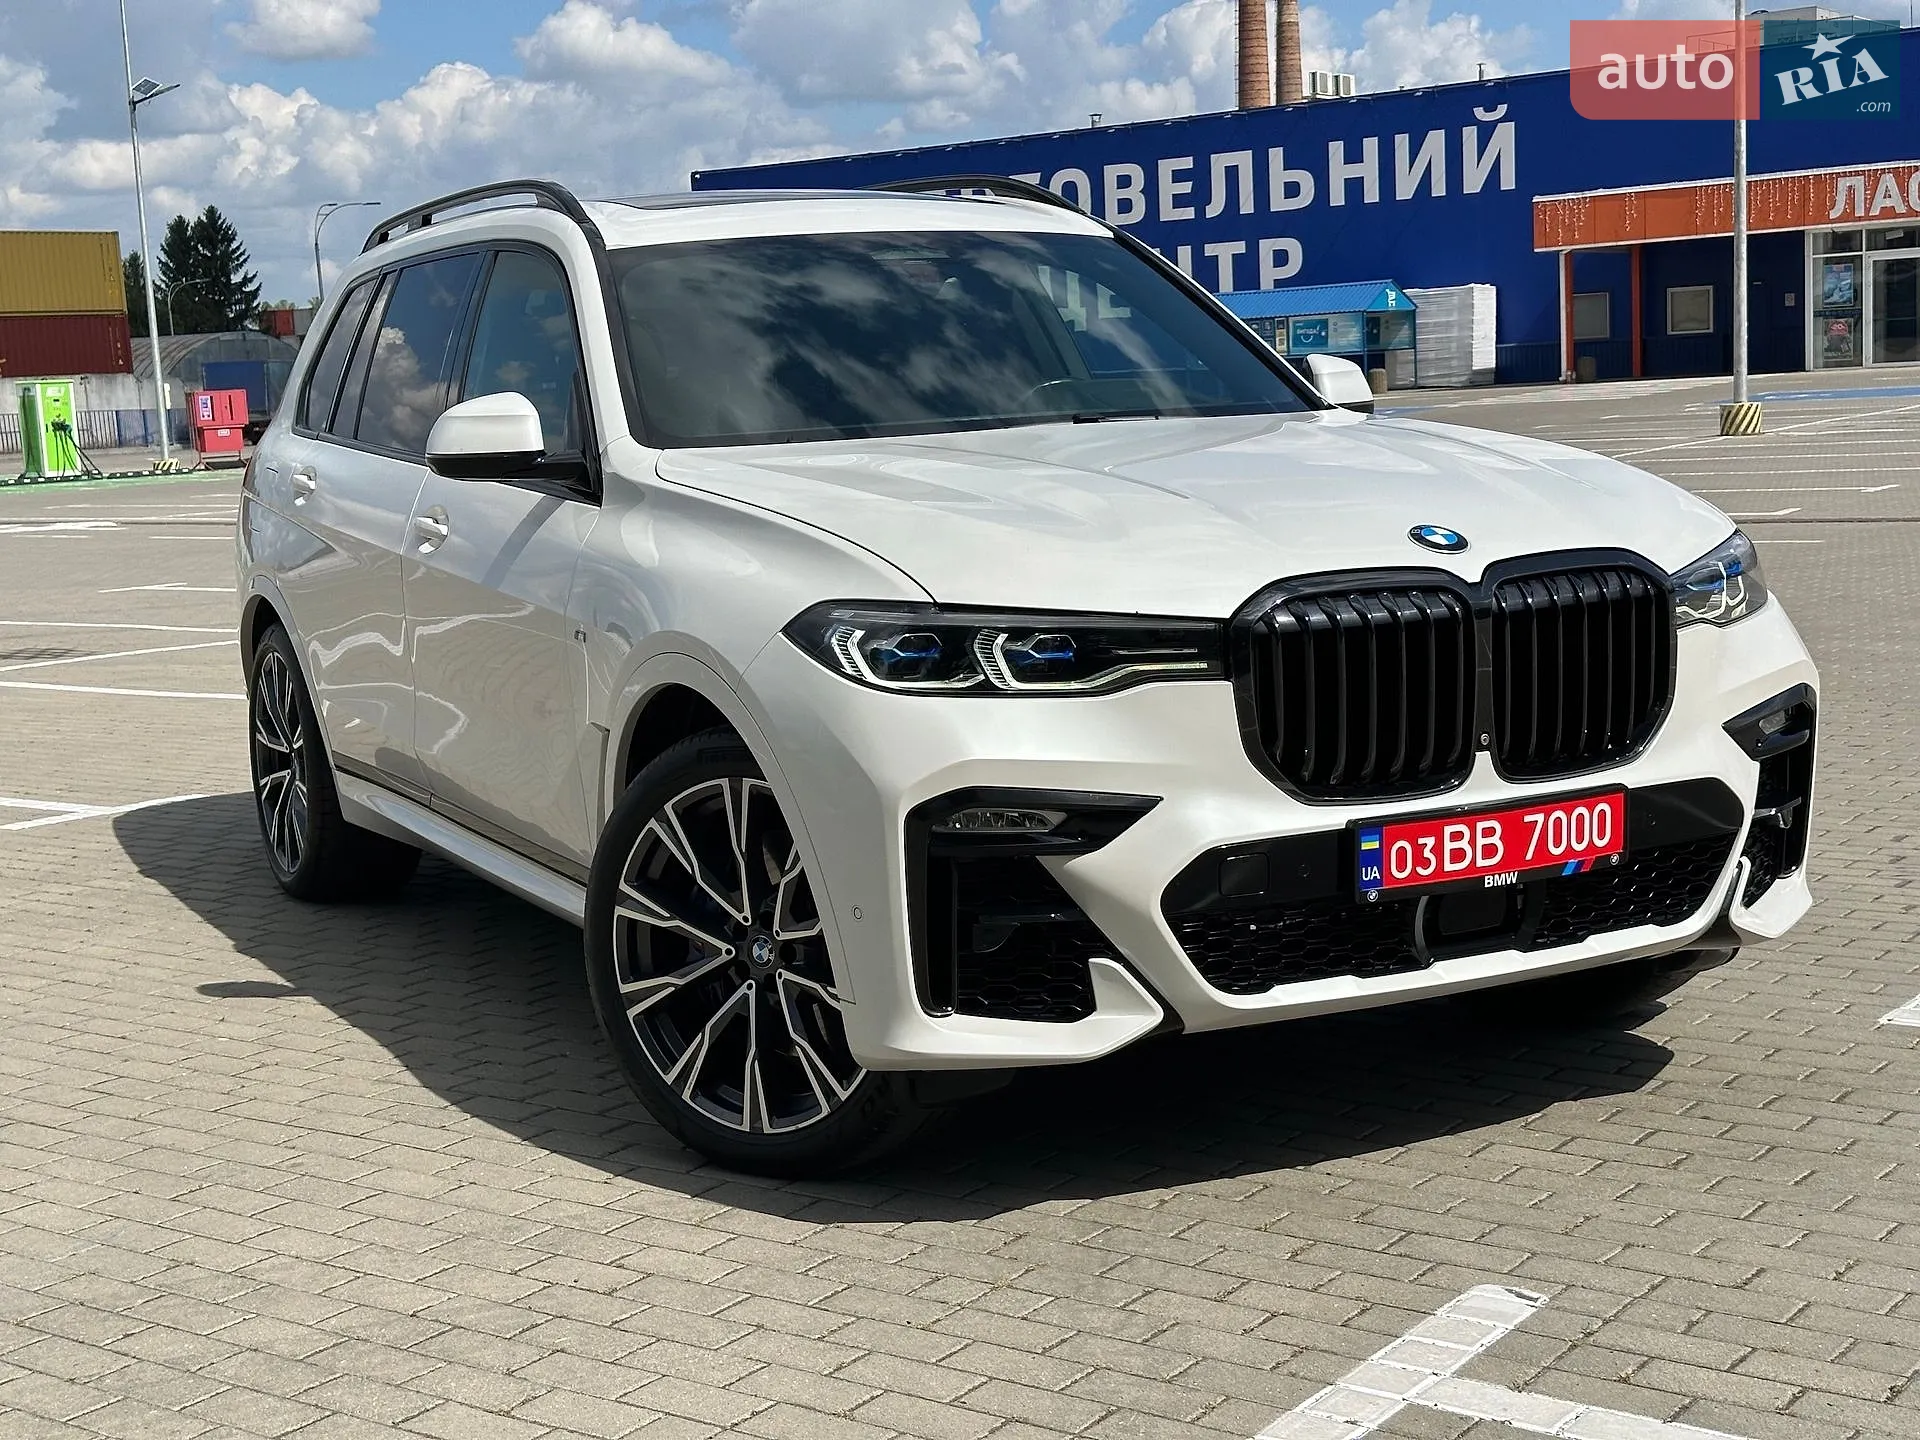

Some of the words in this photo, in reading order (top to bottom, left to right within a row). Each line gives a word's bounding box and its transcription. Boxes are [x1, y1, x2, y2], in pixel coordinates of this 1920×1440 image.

[915, 102, 1517, 226] ОВЕЛЬНИЙ
[1523, 802, 1612, 861] 7000
[1361, 865, 1381, 881] UA
[1484, 871, 1519, 888] BMW
